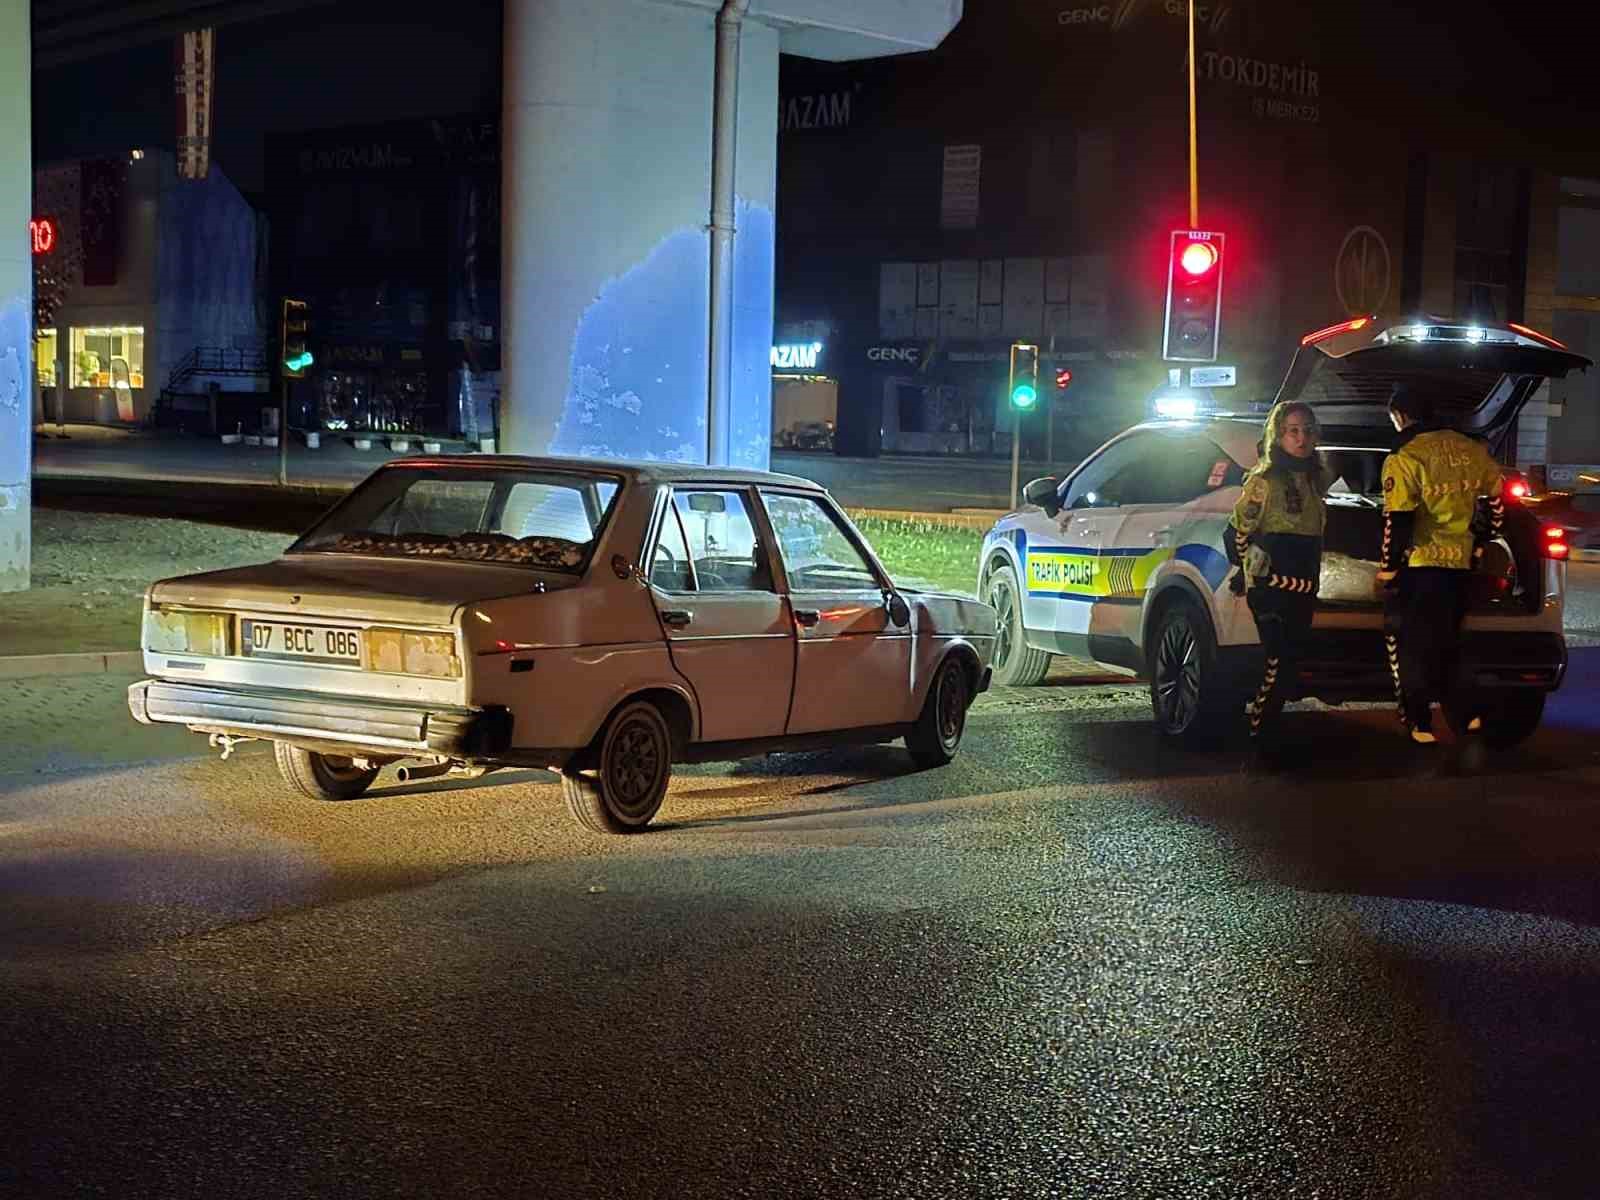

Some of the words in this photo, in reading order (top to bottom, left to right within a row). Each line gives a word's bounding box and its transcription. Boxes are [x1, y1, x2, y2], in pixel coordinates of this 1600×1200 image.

[1031, 559, 1060, 582] TRAFİK
[1063, 560, 1094, 585] POLİSİ
[253, 624, 273, 649] 07
[283, 627, 314, 653] BCC
[325, 630, 358, 656] 086
